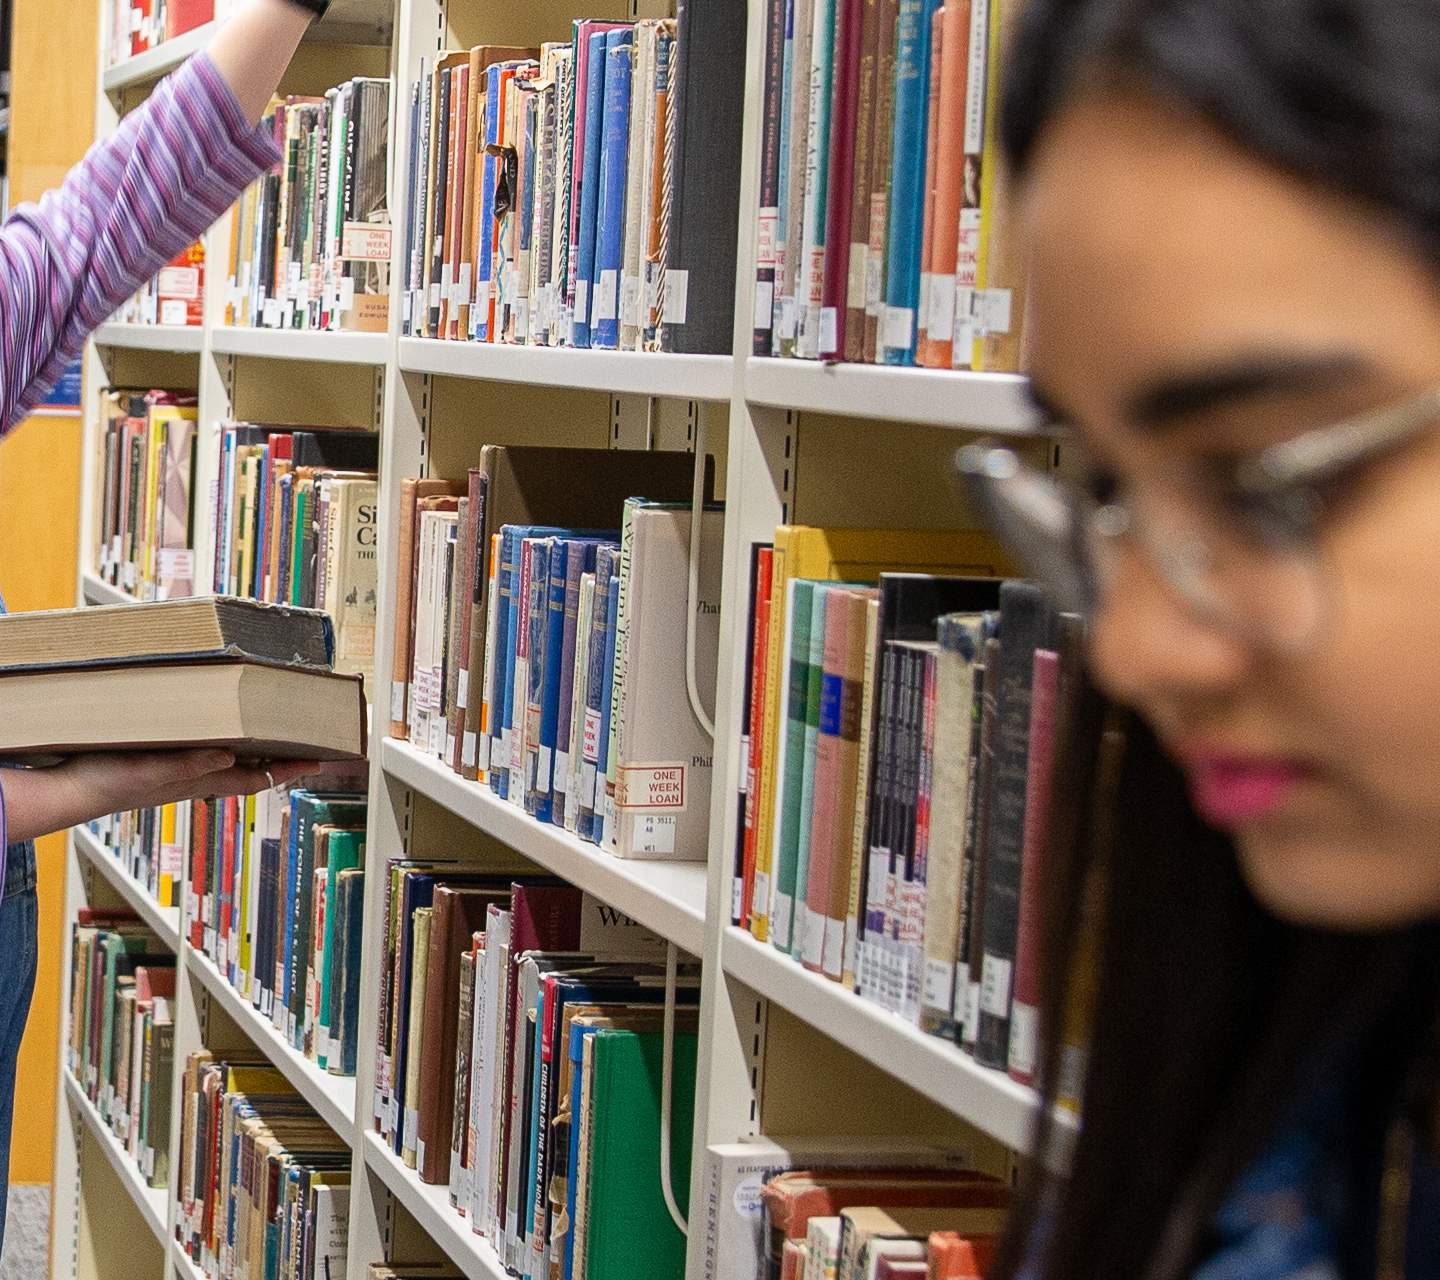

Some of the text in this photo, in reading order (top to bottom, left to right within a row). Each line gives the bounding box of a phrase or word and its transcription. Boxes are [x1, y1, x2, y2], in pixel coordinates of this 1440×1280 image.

[810, 63, 821, 116] Ashes
[806, 144, 817, 196] Ashes
[365, 249, 388, 257] LOAN
[610, 521, 633, 738] William Faulkner
[653, 771, 676, 780] ONE
[692, 756, 713, 768] Phil
[648, 782, 680, 792] WEEK
[649, 794, 679, 803] LOAN
[290, 955, 298, 993] ELIOT
[540, 1063, 549, 1114] CHILDREN
[295, 1220, 303, 1266] POEMS
